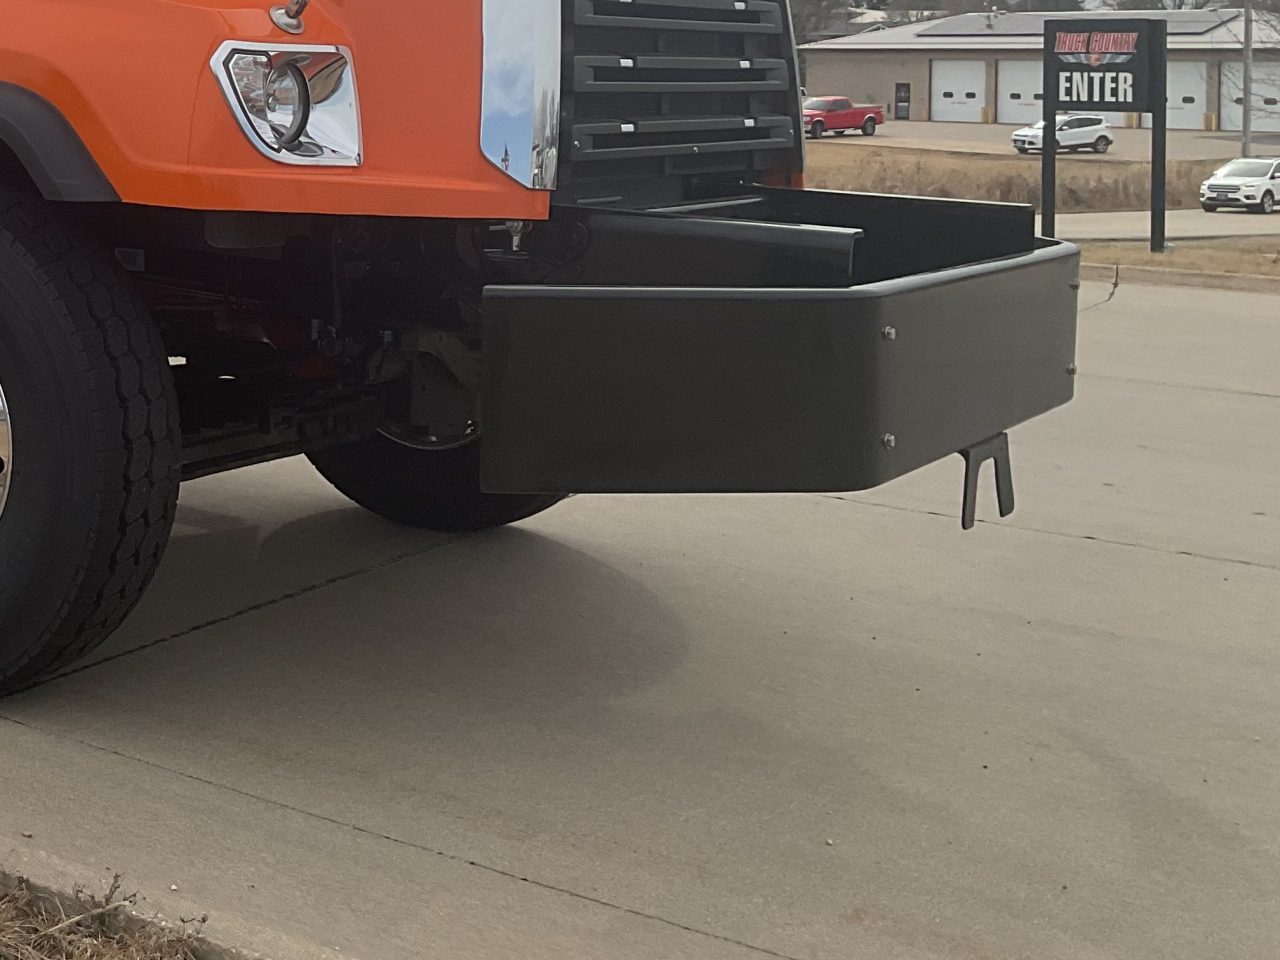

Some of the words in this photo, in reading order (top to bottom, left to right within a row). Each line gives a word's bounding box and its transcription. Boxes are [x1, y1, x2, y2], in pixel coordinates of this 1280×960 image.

[1054, 31, 1089, 53] TRUCK
[1089, 31, 1139, 53] COUNTRY
[1058, 71, 1133, 102] ENTER
